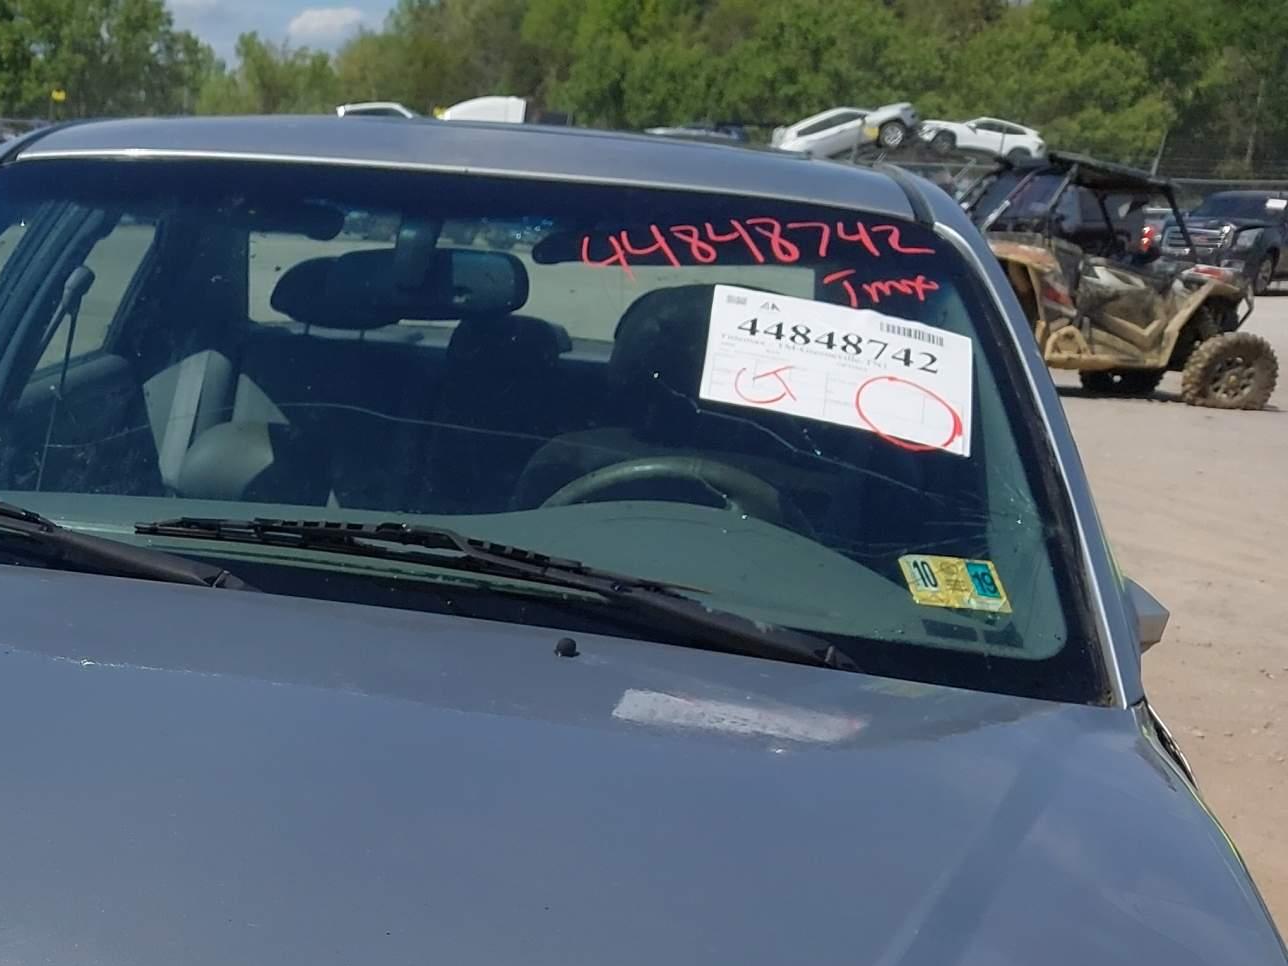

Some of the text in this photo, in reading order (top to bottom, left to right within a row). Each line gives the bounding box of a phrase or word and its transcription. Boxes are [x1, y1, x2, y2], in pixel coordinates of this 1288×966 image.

[580, 216, 936, 284] 44848742
[736, 317, 939, 374] 44848742
[911, 559, 939, 589] 10
